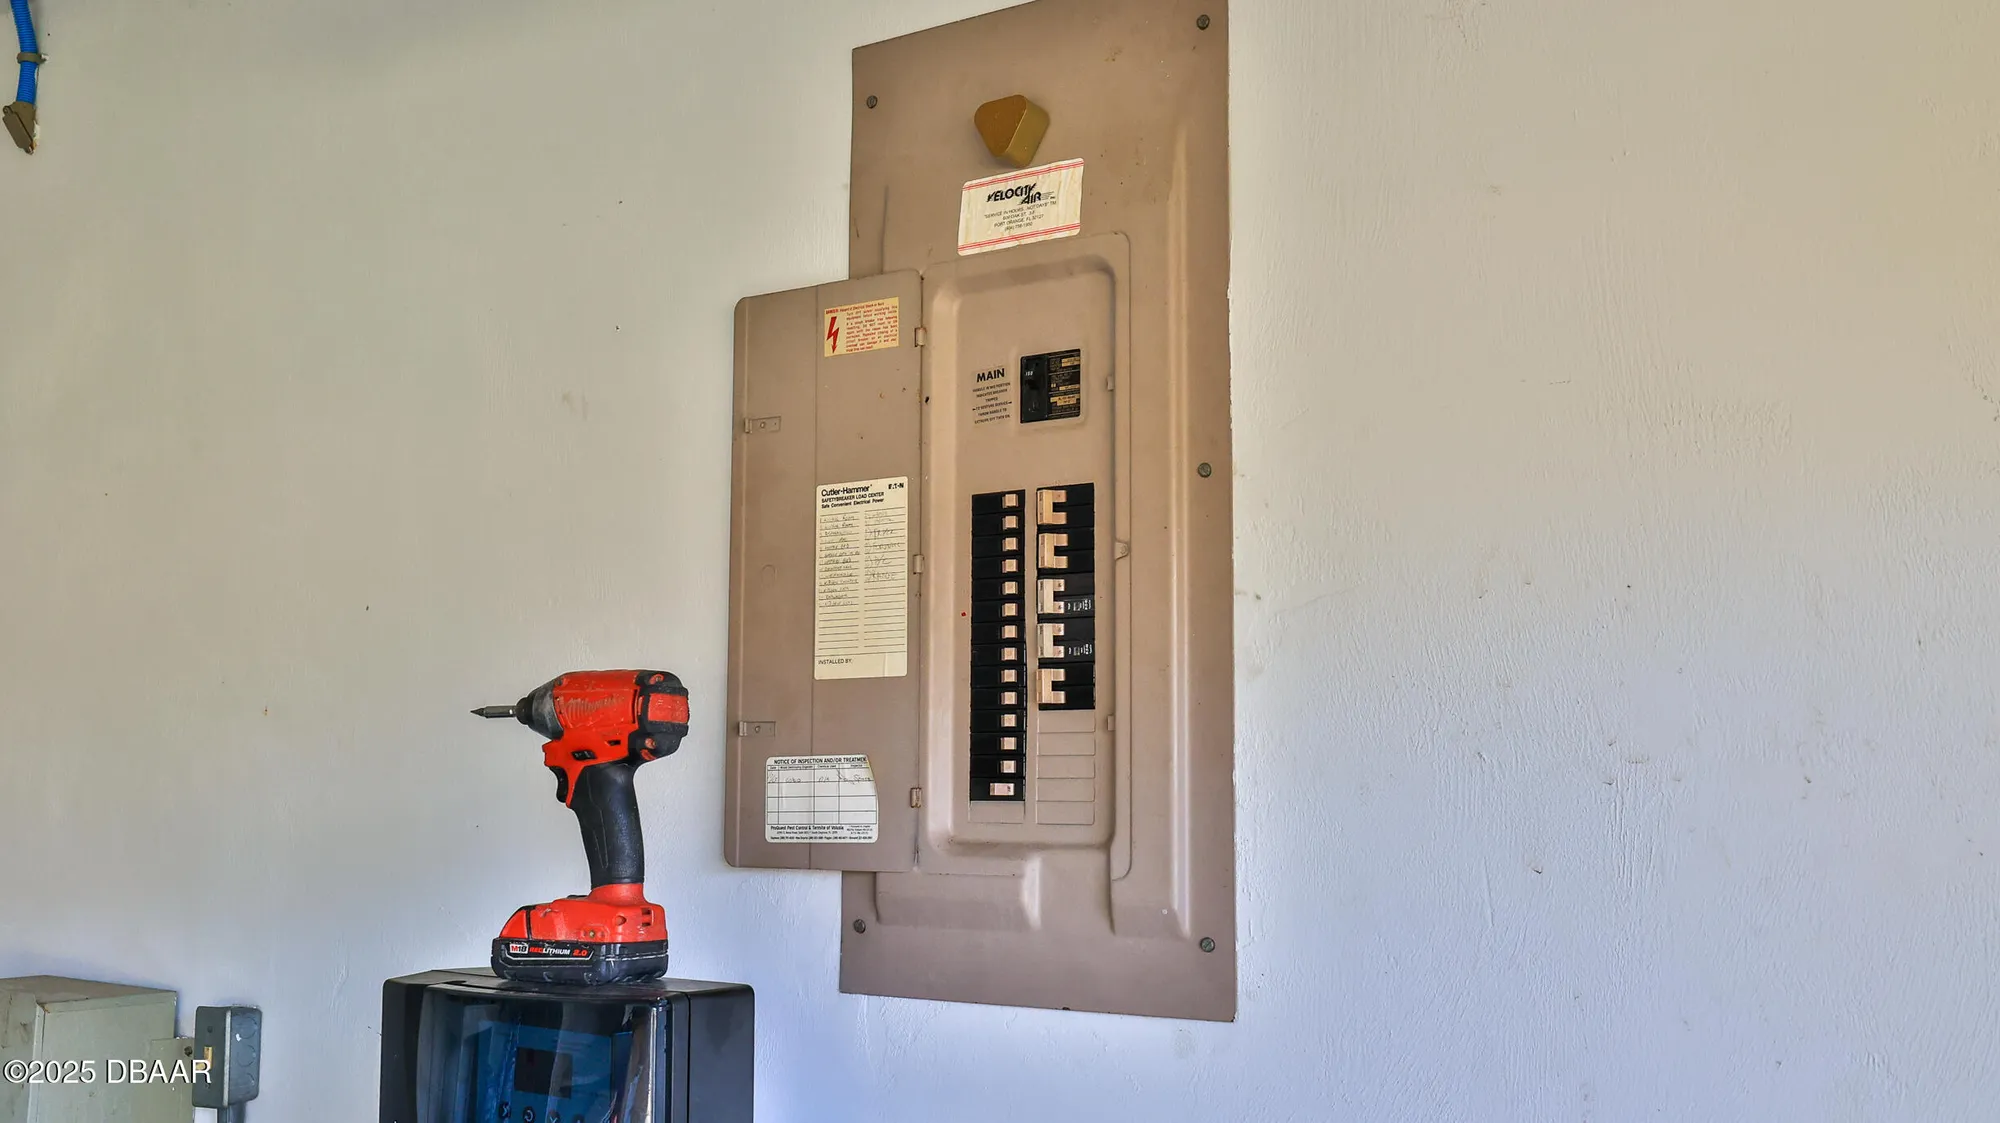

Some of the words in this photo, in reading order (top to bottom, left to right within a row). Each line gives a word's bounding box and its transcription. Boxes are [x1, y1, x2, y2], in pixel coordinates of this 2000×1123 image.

[986, 183, 1036, 202] VELOCITY
[1020, 191, 1041, 204] AIR
[976, 368, 1004, 382] MAIN
[530, 946, 570, 955] REDLITHIUM
